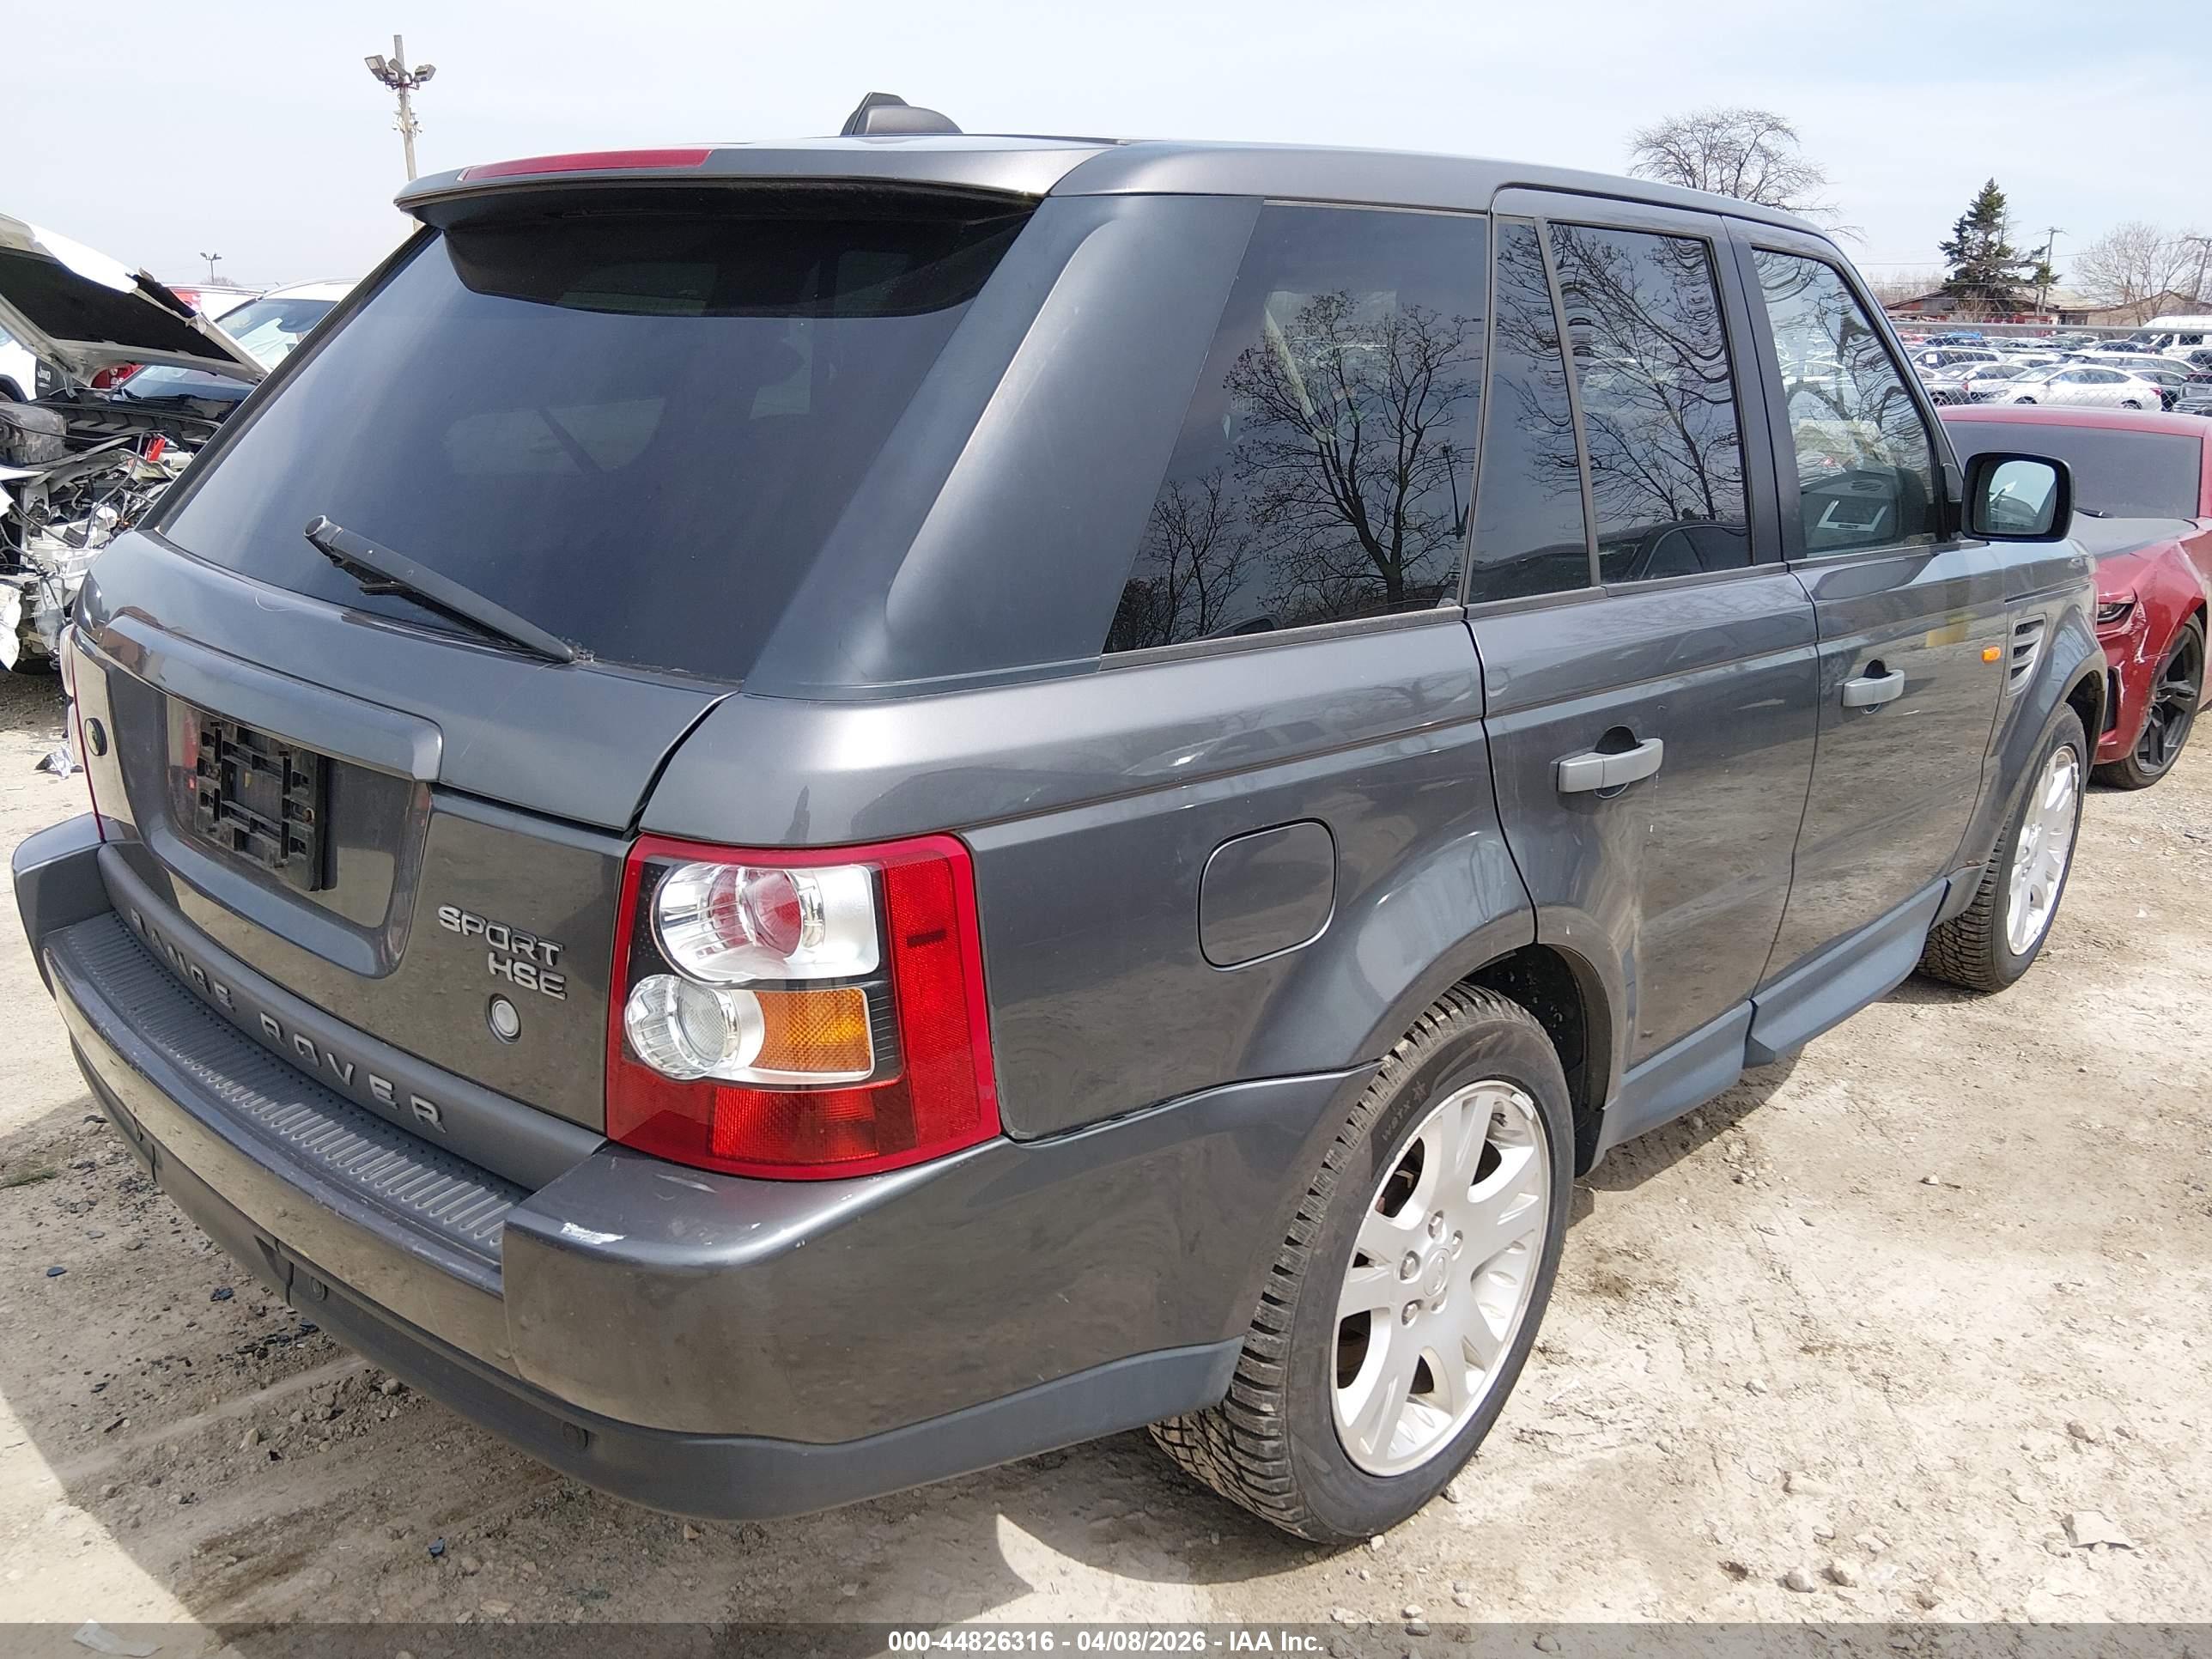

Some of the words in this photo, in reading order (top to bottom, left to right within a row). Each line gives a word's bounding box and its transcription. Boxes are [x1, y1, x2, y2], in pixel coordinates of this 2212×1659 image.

[438, 903, 564, 967] SPORT
[488, 951, 567, 1001] HSE
[131, 908, 236, 1012] RANGE
[260, 1012, 447, 1133] ROVER
